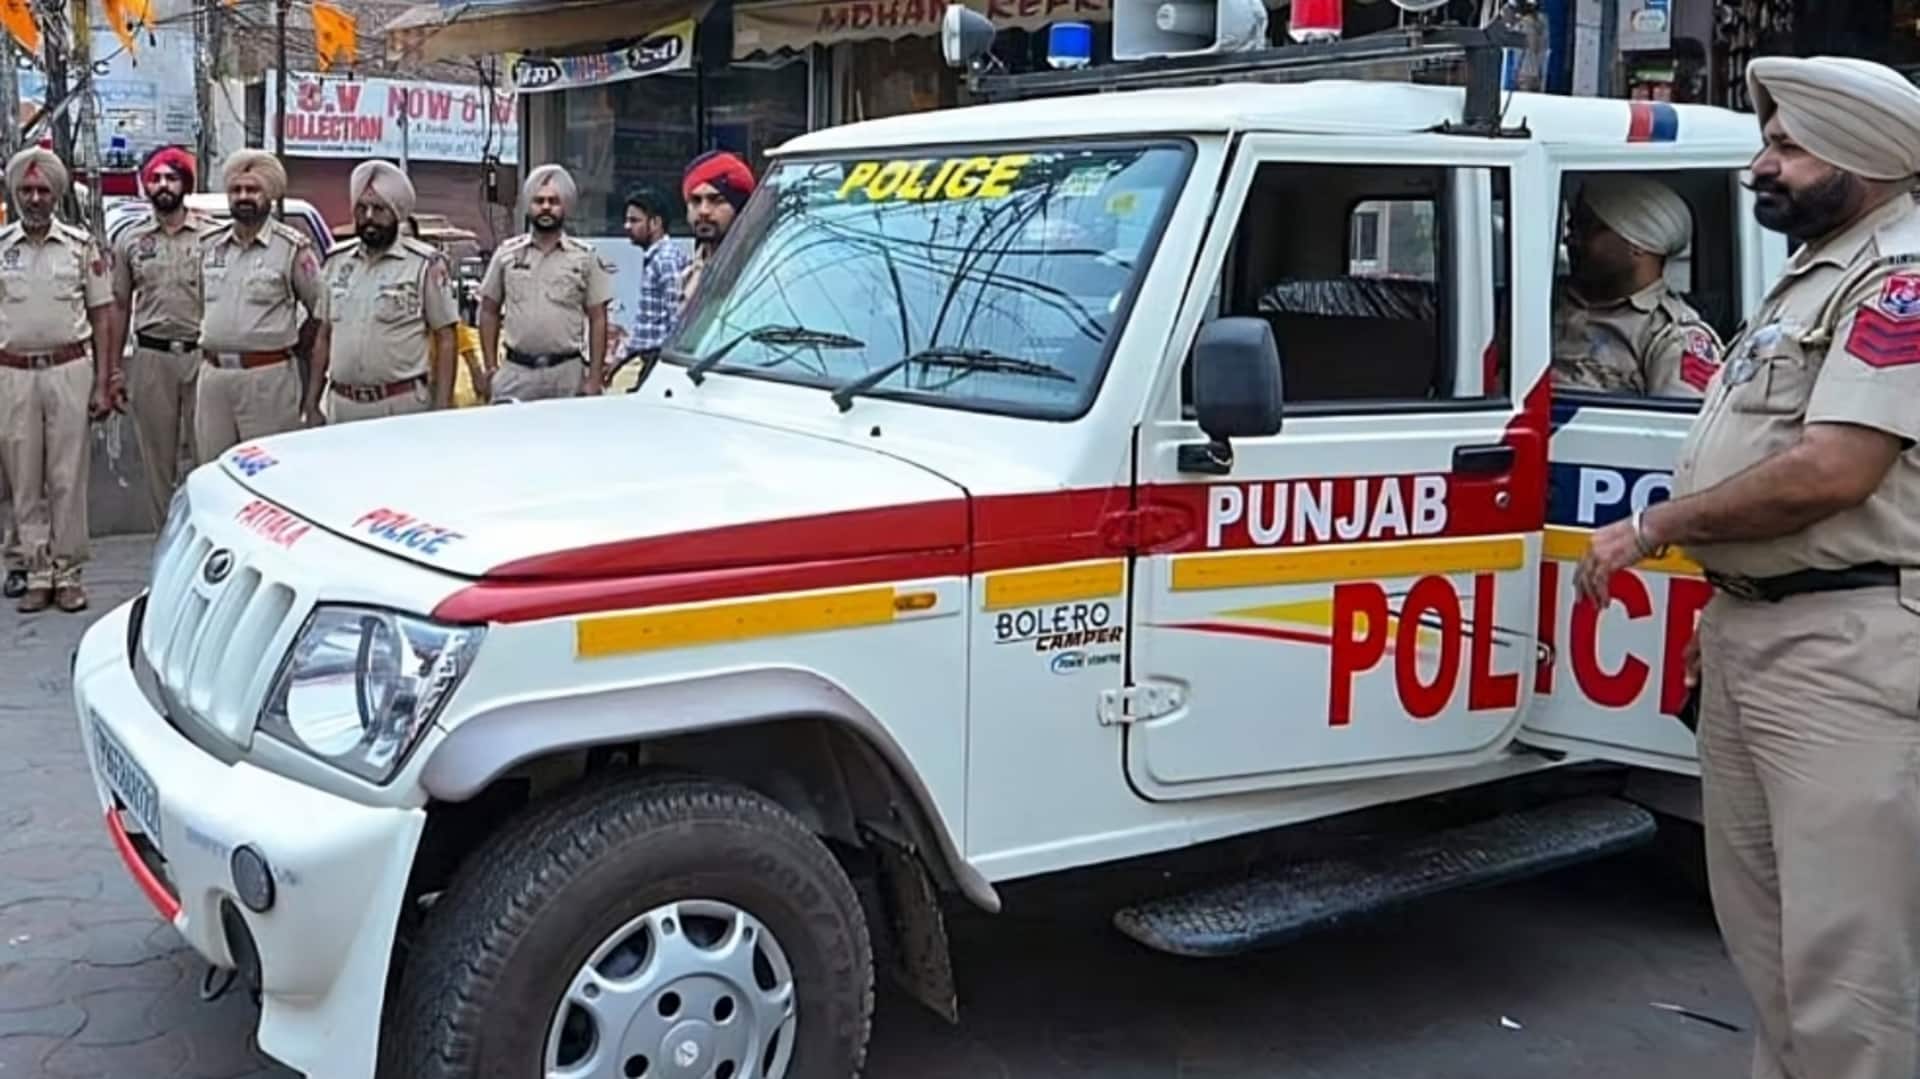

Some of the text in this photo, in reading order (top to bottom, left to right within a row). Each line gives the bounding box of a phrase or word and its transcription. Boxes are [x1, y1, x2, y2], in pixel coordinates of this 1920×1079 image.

[836, 154, 1032, 201] POLICE
[234, 500, 312, 550] PATIALA
[351, 507, 467, 555] POLICE
[1206, 475, 1448, 548] PUNJAB
[994, 602, 1110, 640] BOLERO
[1035, 626, 1123, 652] CAMPER
